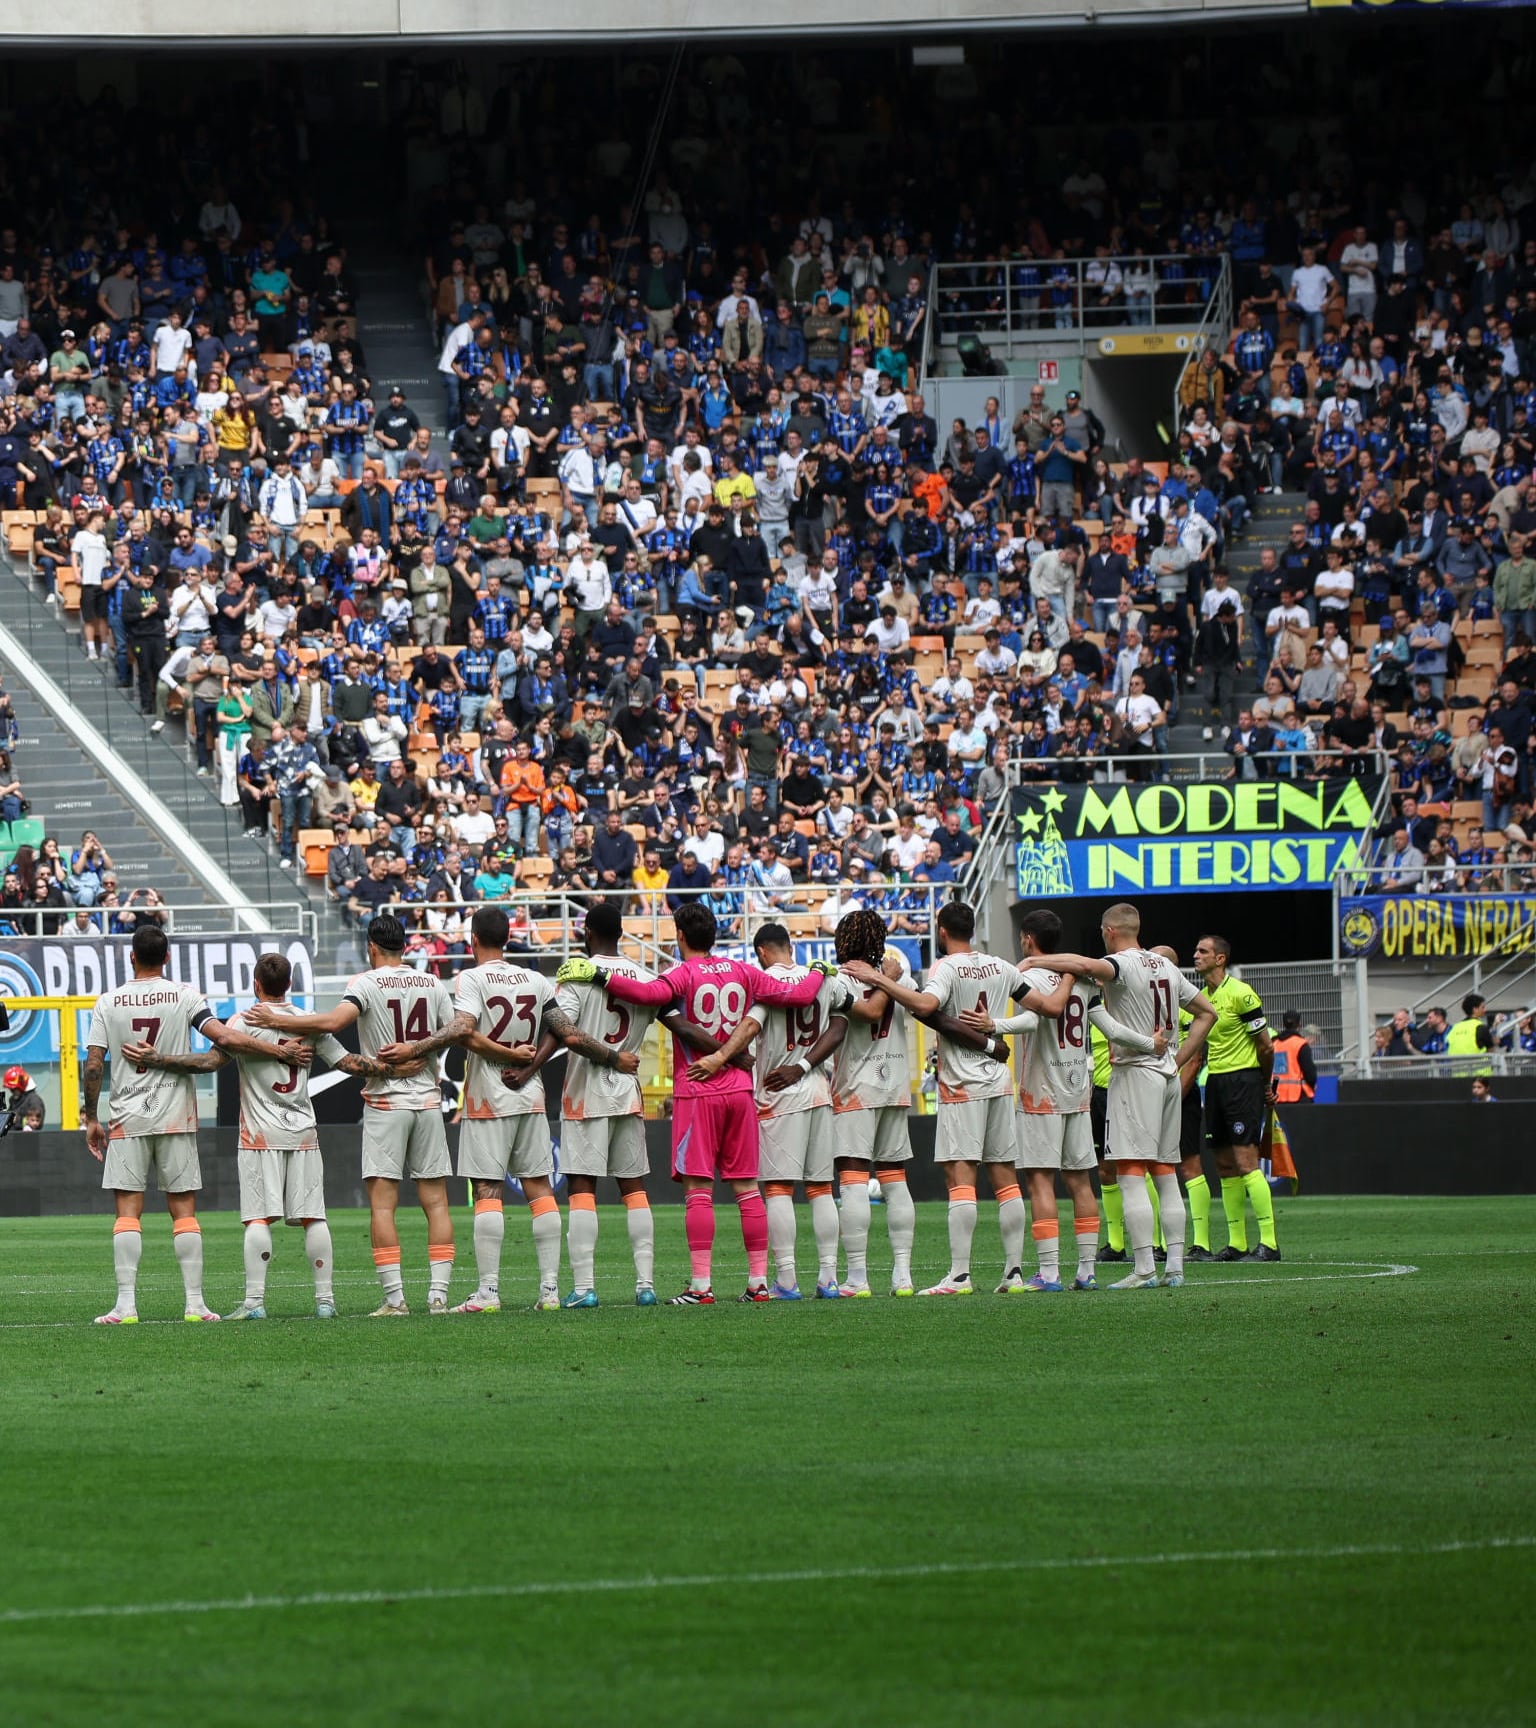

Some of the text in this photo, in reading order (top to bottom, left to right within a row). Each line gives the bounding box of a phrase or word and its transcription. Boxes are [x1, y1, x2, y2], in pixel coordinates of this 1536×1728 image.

[1076, 778, 1378, 837] MODENA
[1087, 835, 1369, 890] INTERISTA
[1382, 899, 1457, 957] OPERA
[43, 942, 314, 1052] BRUHERO
[113, 991, 178, 1008] PELLEGRINI
[376, 976, 435, 989] SHOMURODOV
[485, 972, 530, 986] MANCINI
[1149, 978, 1173, 1032] 11
[387, 997, 431, 1044] 14
[486, 994, 537, 1049] 23
[693, 981, 747, 1036] 99
[131, 1017, 161, 1074] 7
